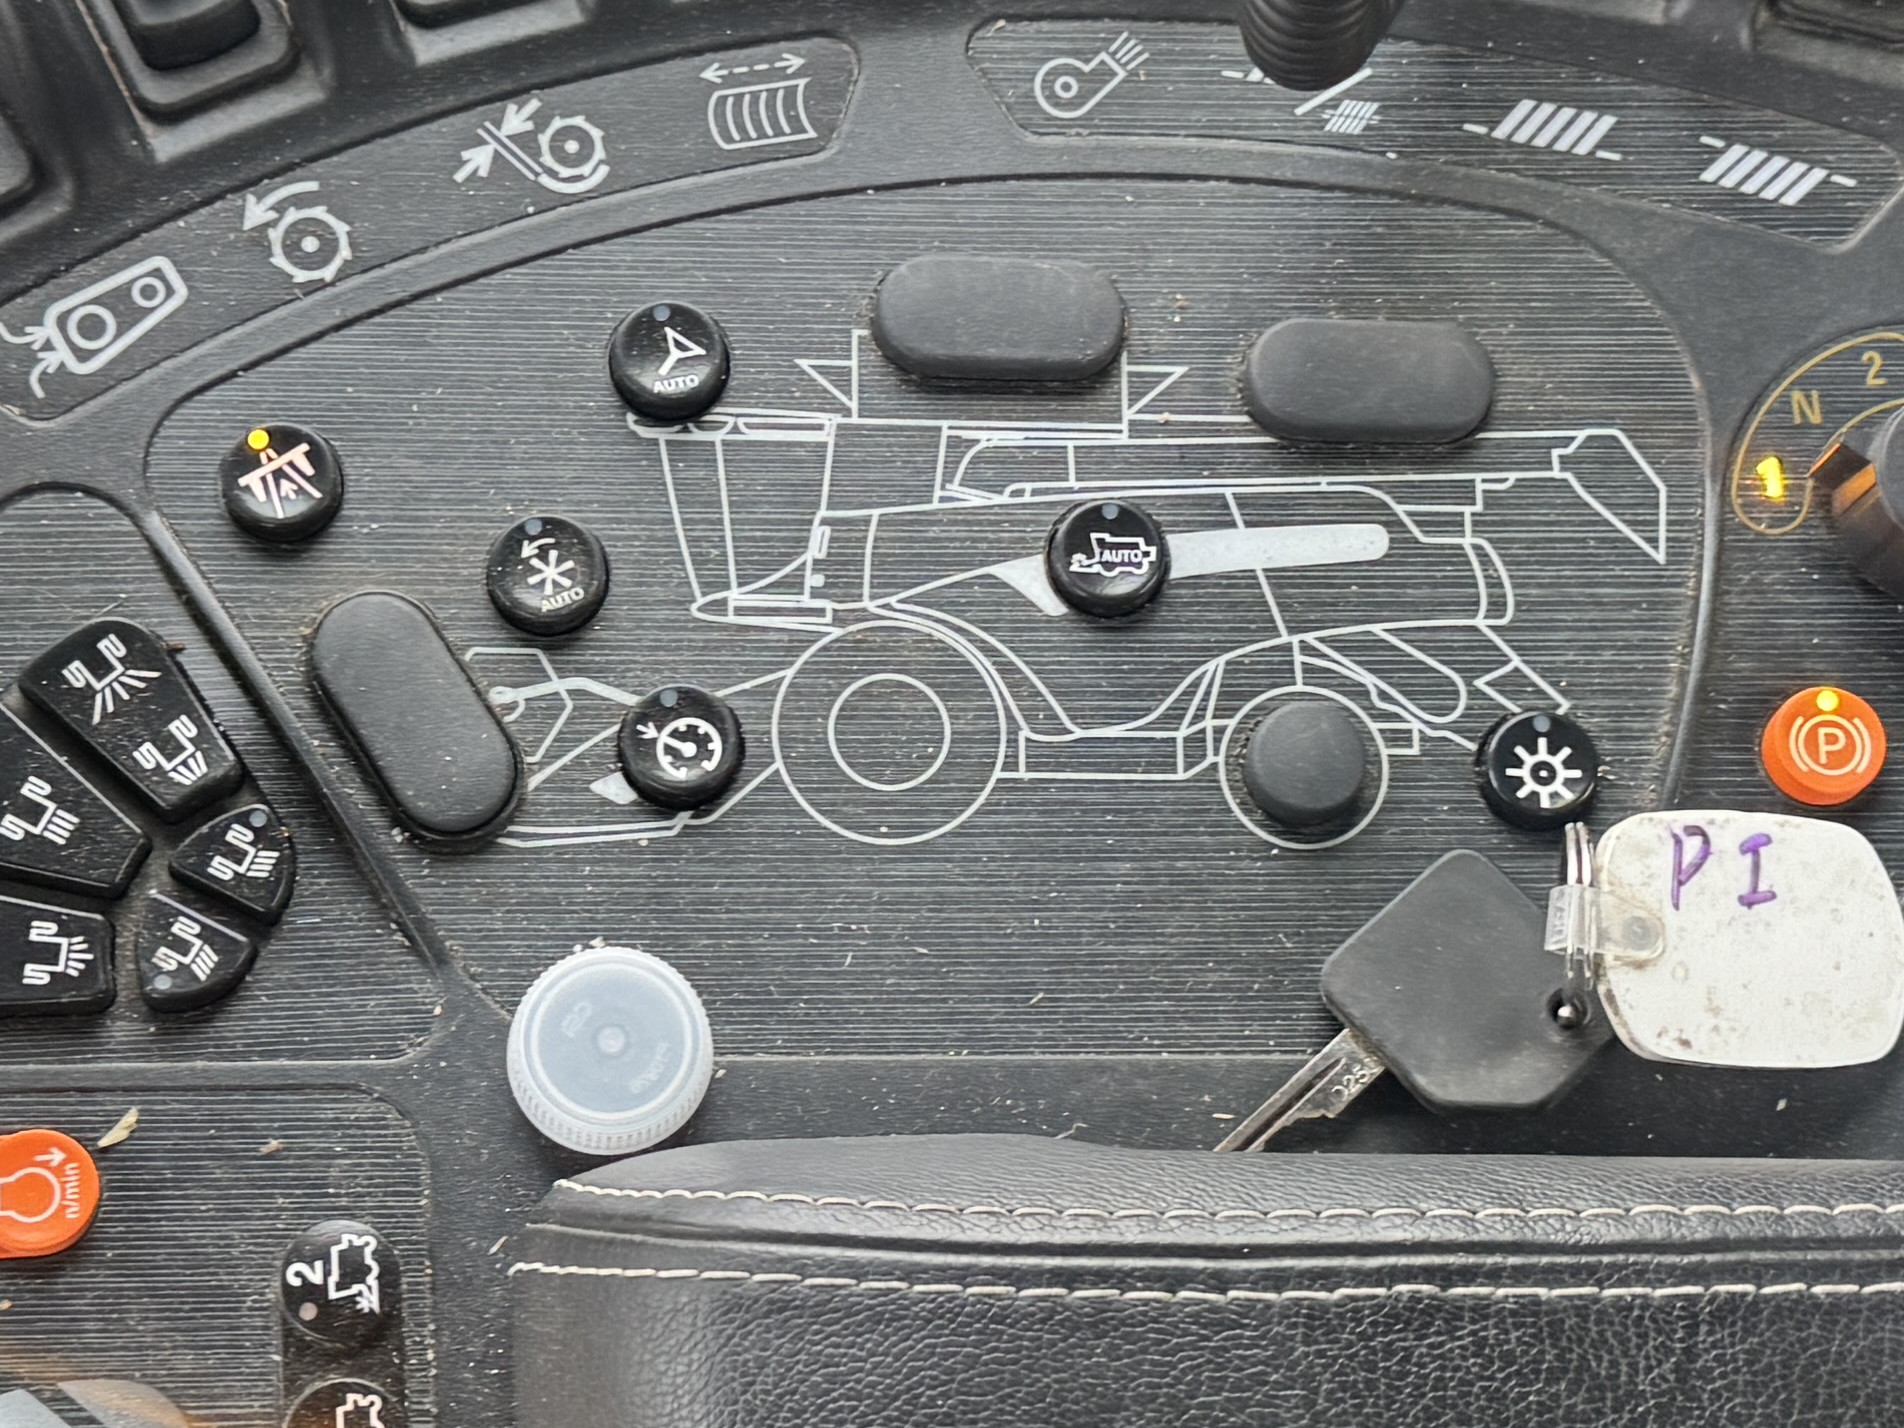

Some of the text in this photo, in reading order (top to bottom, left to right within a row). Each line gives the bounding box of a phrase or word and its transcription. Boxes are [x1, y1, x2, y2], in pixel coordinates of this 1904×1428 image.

[653, 375, 699, 393] AUTO
[1861, 351, 1887, 386] 2
[1791, 391, 1822, 425] N
[1756, 456, 1784, 501] 1
[1101, 549, 1142, 563] AUTO
[542, 588, 584, 612] AUTO
[1818, 728, 1845, 763] P
[62, 1162, 80, 1219] n/min
[286, 1260, 323, 1286] 2
